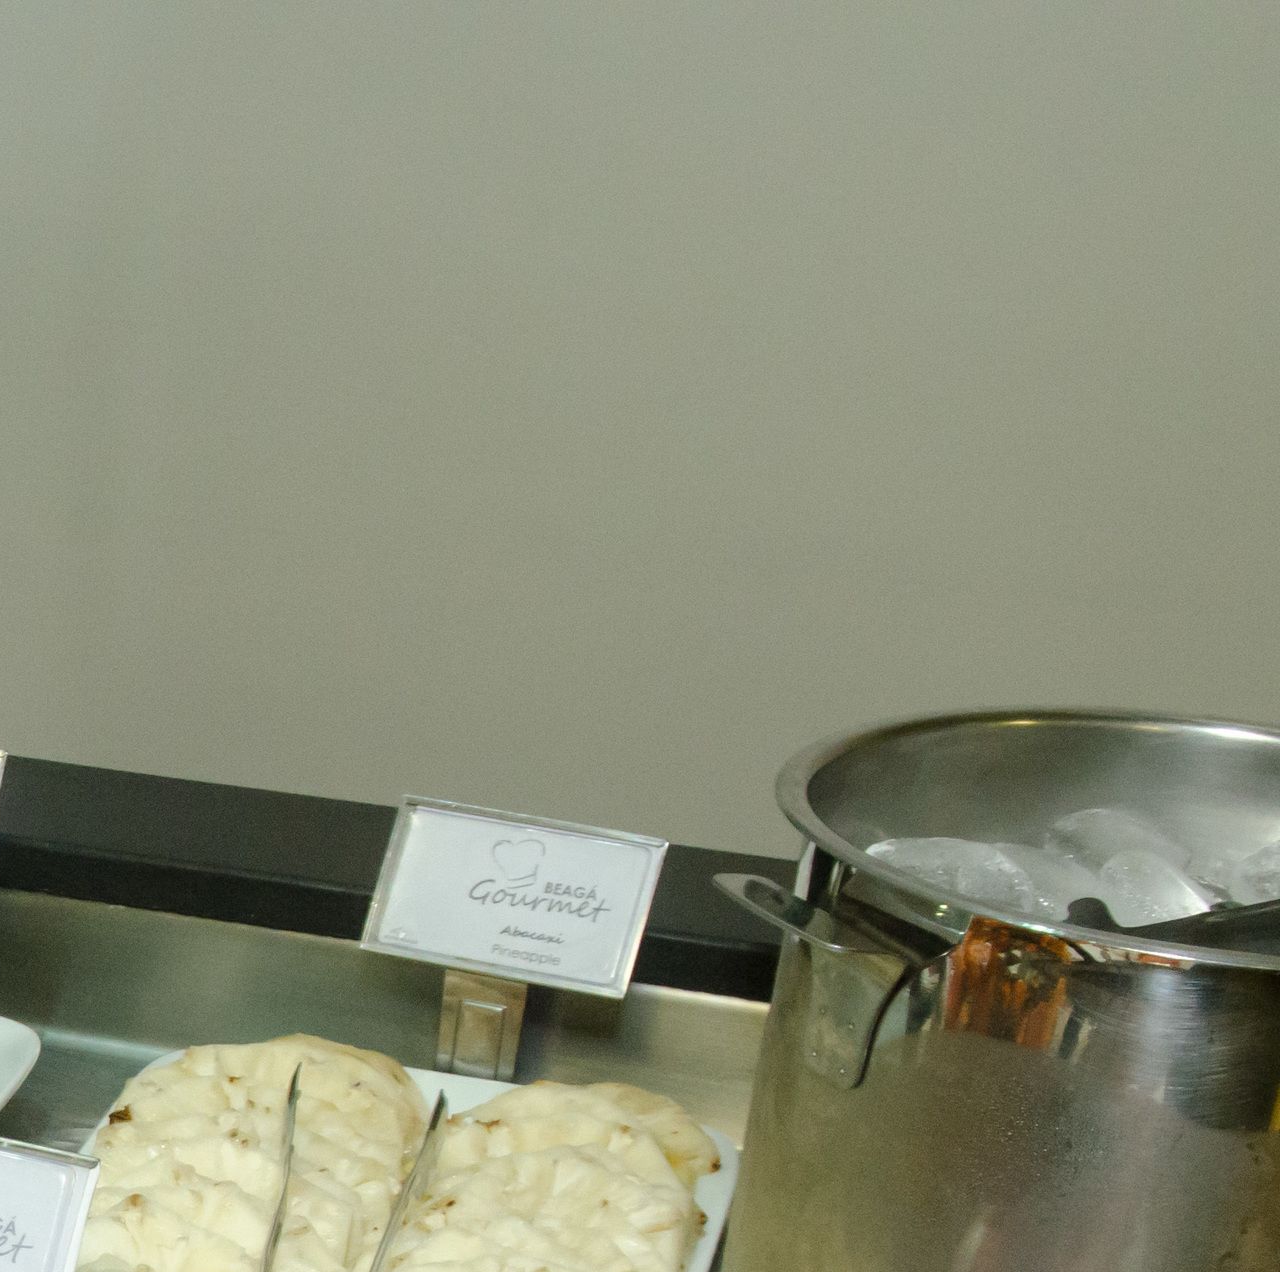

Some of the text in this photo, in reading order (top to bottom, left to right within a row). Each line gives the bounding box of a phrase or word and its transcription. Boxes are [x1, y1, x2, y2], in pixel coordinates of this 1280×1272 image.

[468, 879, 611, 923] Gourmet
[544, 882, 598, 900] BEAGÁ
[499, 925, 565, 945] Abacaxi
[492, 944, 562, 966] Pineapple
